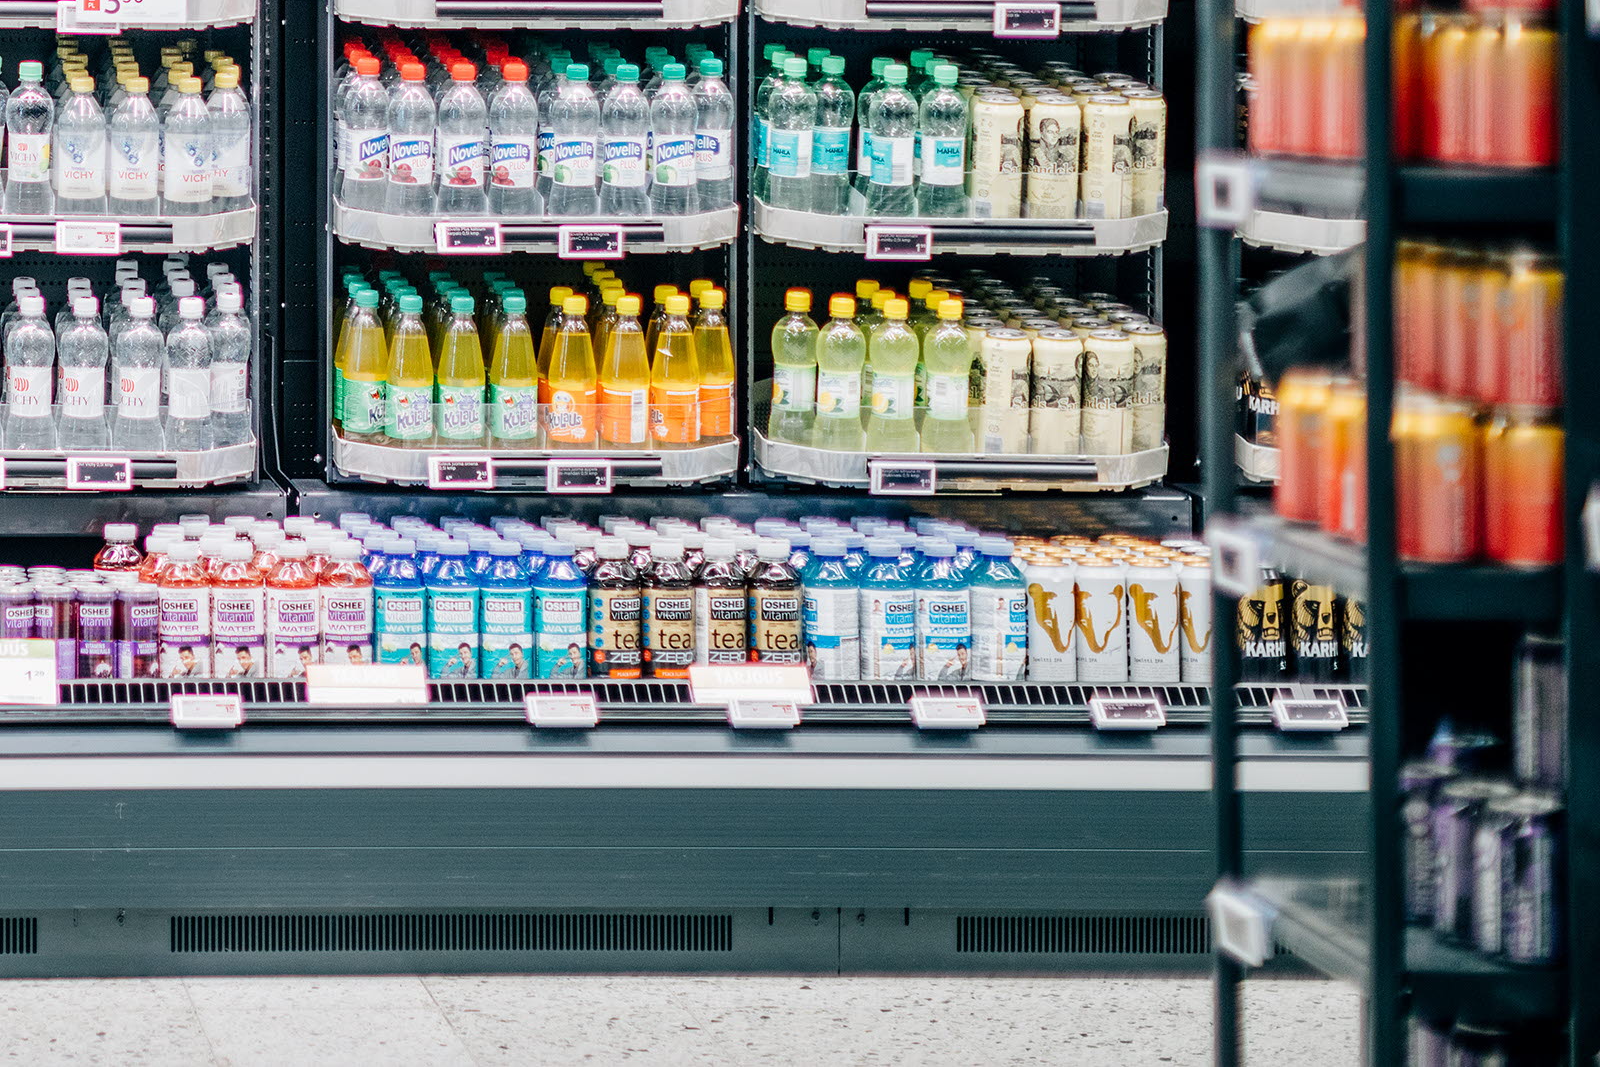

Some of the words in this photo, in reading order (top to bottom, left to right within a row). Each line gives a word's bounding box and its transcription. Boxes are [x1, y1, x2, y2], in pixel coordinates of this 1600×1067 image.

[696, 138, 716, 149] elle
[393, 142, 429, 158] Novelle
[493, 145, 528, 161] Novelle
[556, 143, 593, 160] Novelle
[605, 143, 640, 158] Novelle
[658, 142, 694, 160] Novelle
[10, 151, 37, 162] VICHY
[696, 153, 712, 162] PLUS
[412, 159, 427, 167] PLUS
[510, 161, 525, 170] PLUS
[573, 159, 589, 168] PLUS
[620, 159, 637, 168] PLUS
[678, 159, 692, 167] PLUS
[64, 171, 94, 179] VICHY
[119, 171, 148, 179] VICHY
[12, 394, 39, 405] ICHY
[66, 395, 89, 406] CHY
[121, 396, 145, 406] CHY
[1249, 395, 1280, 415] KARH
[164, 602, 194, 610] OSHEE
[219, 602, 251, 611] OSHEE
[281, 603, 313, 611] OSHEE
[389, 602, 421, 610] OSHEE
[437, 602, 470, 610] OSHEE
[487, 602, 521, 611] OSHEE
[546, 602, 579, 611] OSHEE
[658, 600, 690, 609] OSHEE
[713, 600, 744, 608] OSHEE
[765, 600, 796, 609] OSHEE
[933, 604, 965, 613] OSHEE
[81, 608, 109, 616] OSHEE
[162, 612, 197, 621] vitamin
[328, 610, 365, 621] vitamin
[657, 610, 691, 620] vitamin
[762, 610, 799, 621] vitamin
[218, 612, 254, 622] vitamin
[279, 612, 314, 623] vitamin
[930, 613, 967, 624] vitamin
[80, 618, 111, 627] vitamin
[486, 625, 524, 633] WATER
[544, 625, 582, 633] WATER
[658, 629, 691, 649] tea
[766, 629, 799, 649] tea
[656, 652, 693, 663] ZERO
[709, 651, 746, 662] ZERO
[762, 652, 800, 663] ZERO
